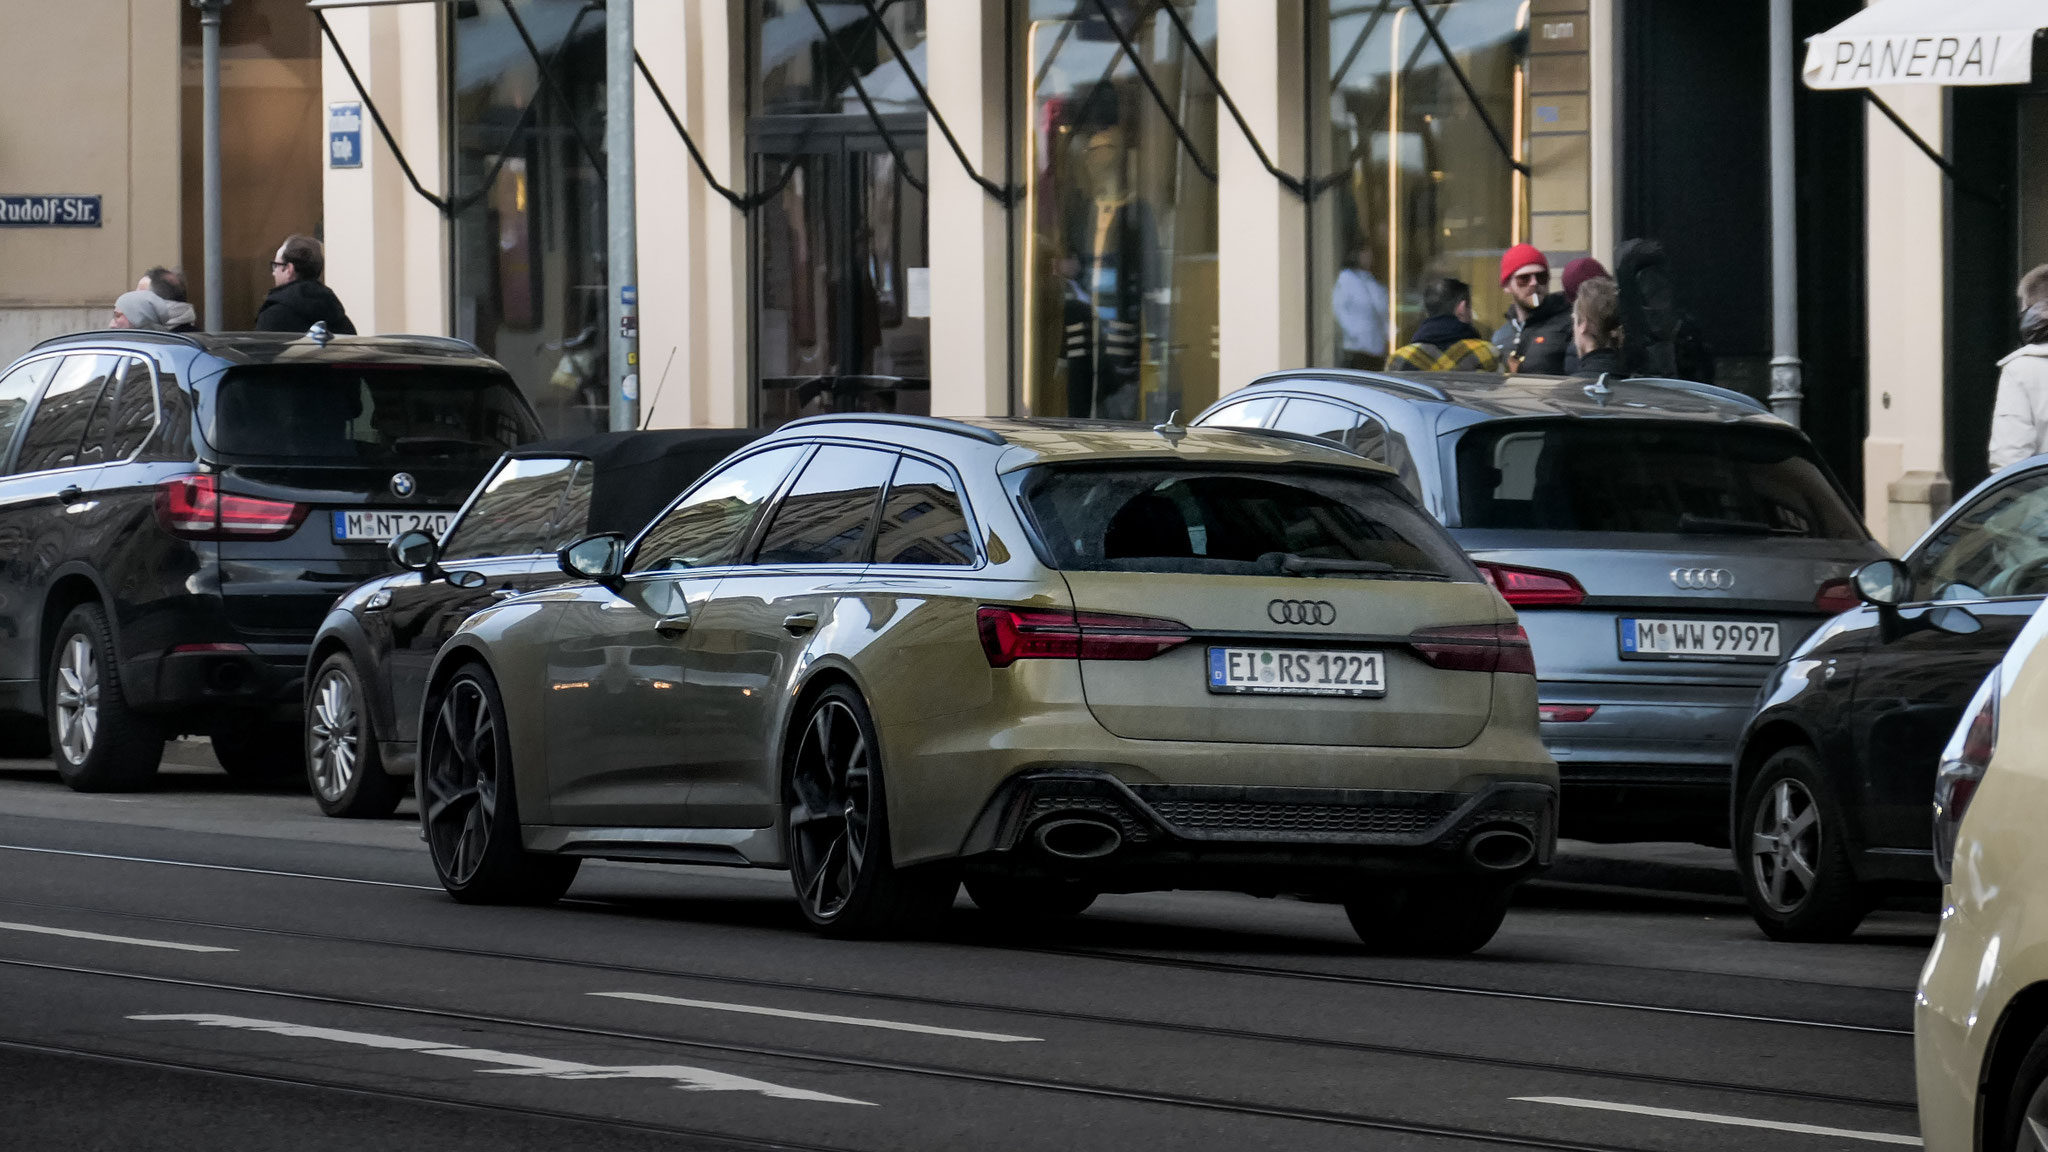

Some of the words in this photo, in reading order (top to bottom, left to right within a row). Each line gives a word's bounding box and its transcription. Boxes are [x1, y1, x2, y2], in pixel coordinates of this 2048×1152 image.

[1831, 36, 2001, 81] PANERAI
[348, 514, 363, 536] M
[376, 514, 403, 536] NT
[1638, 623, 1655, 649] M
[1672, 623, 1705, 650] WW
[1712, 625, 1775, 652] 9997
[1228, 652, 1259, 682] EI
[1278, 653, 1311, 683] RS
[1317, 655, 1379, 686] 1221
